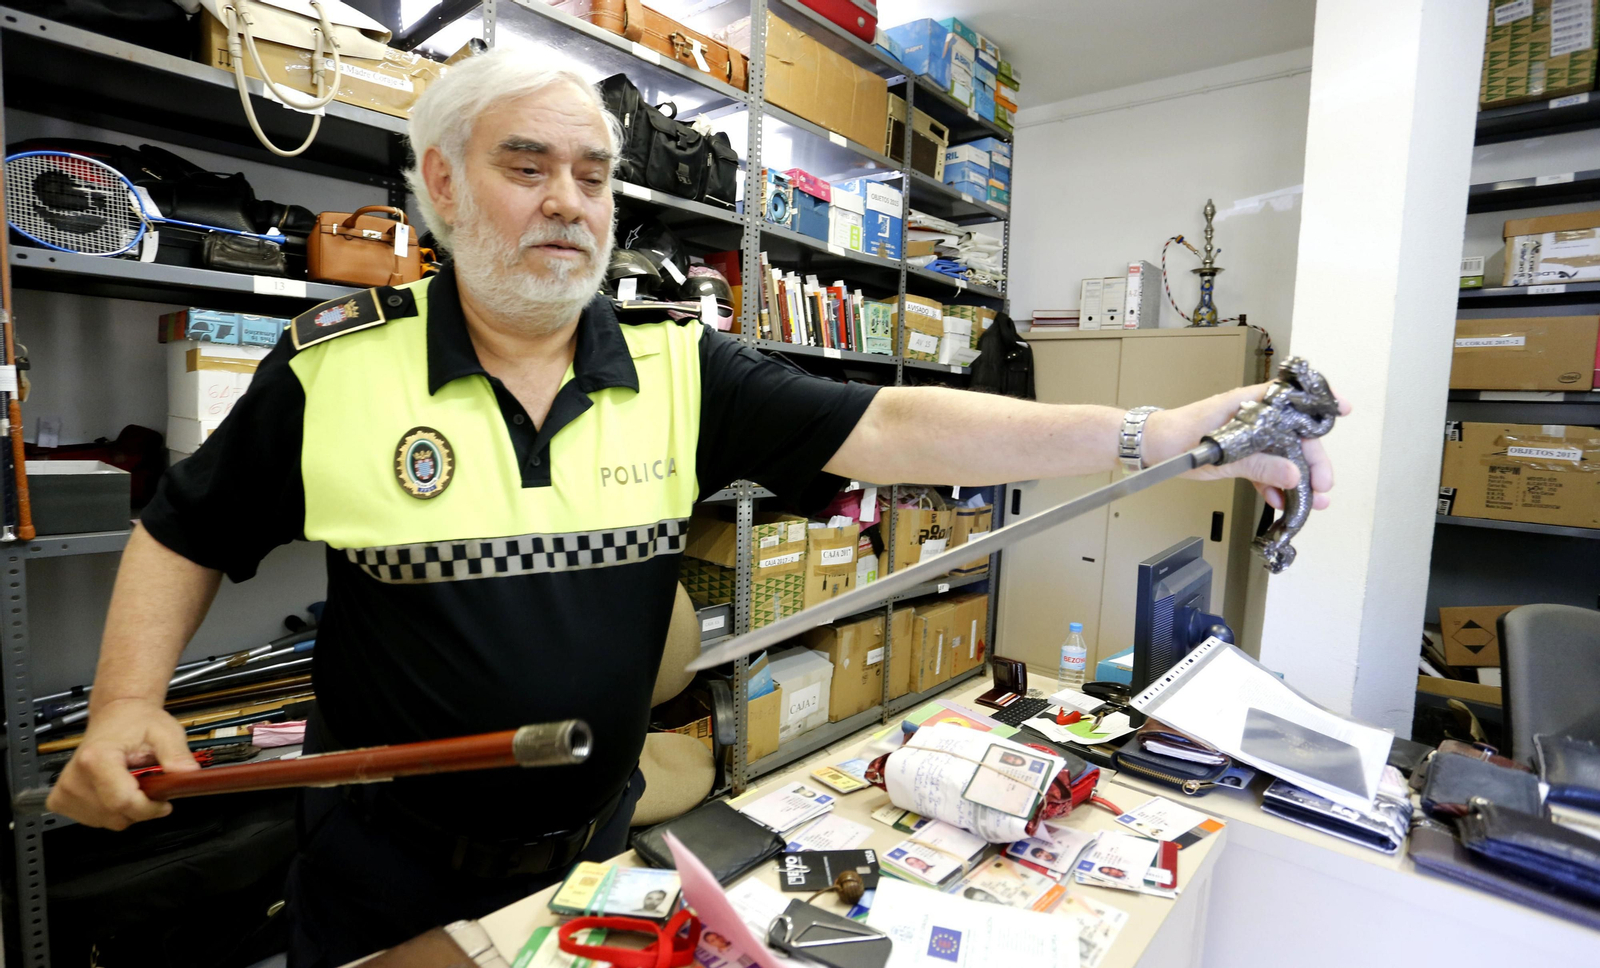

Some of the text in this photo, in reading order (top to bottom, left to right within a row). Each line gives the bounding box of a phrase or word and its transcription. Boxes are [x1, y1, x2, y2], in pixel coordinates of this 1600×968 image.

[346, 65, 371, 79] Madre
[372, 72, 397, 86] Coraje
[945, 151, 959, 161] RIL
[870, 193, 890, 204] OBJETOS
[274, 281, 285, 291] 13
[906, 303, 930, 315] AVISADO
[244, 328, 276, 338] Amazing
[1509, 447, 1577, 458] OBJETOS 2017
[601, 457, 677, 487] POLICA
[823, 548, 851, 558] CAJA 2017
[764, 559, 776, 567] CAJA
[789, 699, 810, 715] CAJA
[864, 850, 876, 864] VISA
